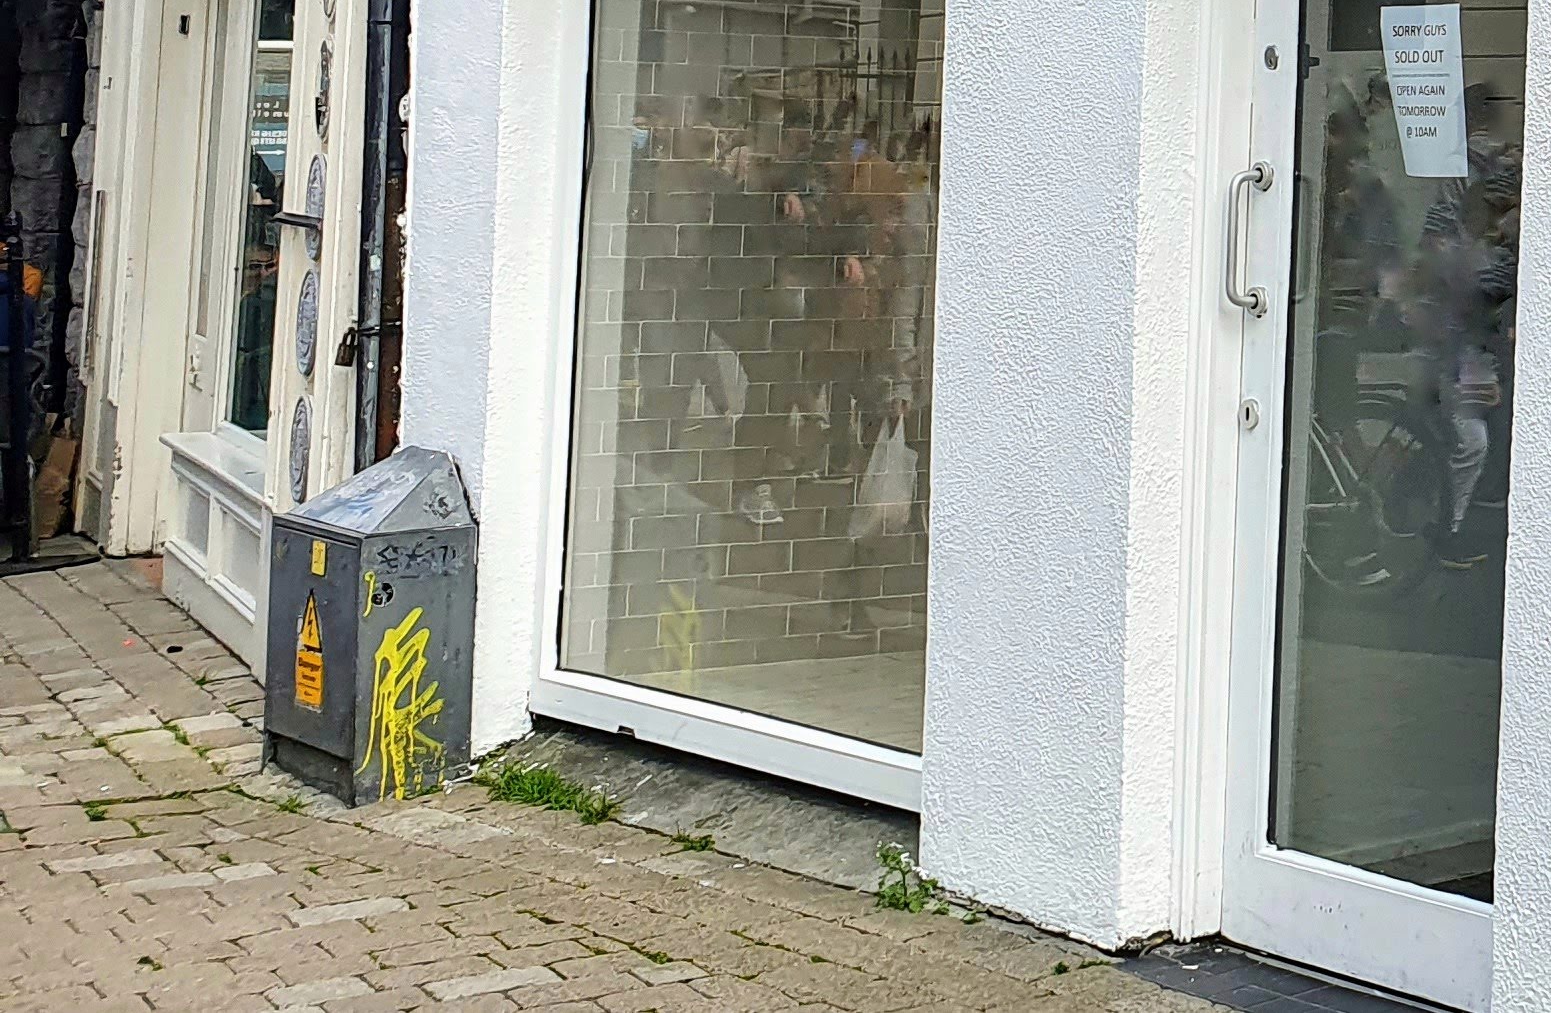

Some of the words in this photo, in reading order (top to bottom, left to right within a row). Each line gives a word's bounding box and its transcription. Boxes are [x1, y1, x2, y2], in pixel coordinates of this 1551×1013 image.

[1392, 25, 1422, 38] SORRY
[1394, 50, 1420, 64] SOLD
[1422, 49, 1445, 63] OUT
[1396, 85, 1417, 96] OPEN
[1418, 85, 1446, 96] AGAIN
[1397, 105, 1447, 117] TOMORROW
[1414, 126, 1438, 138] 10AM
